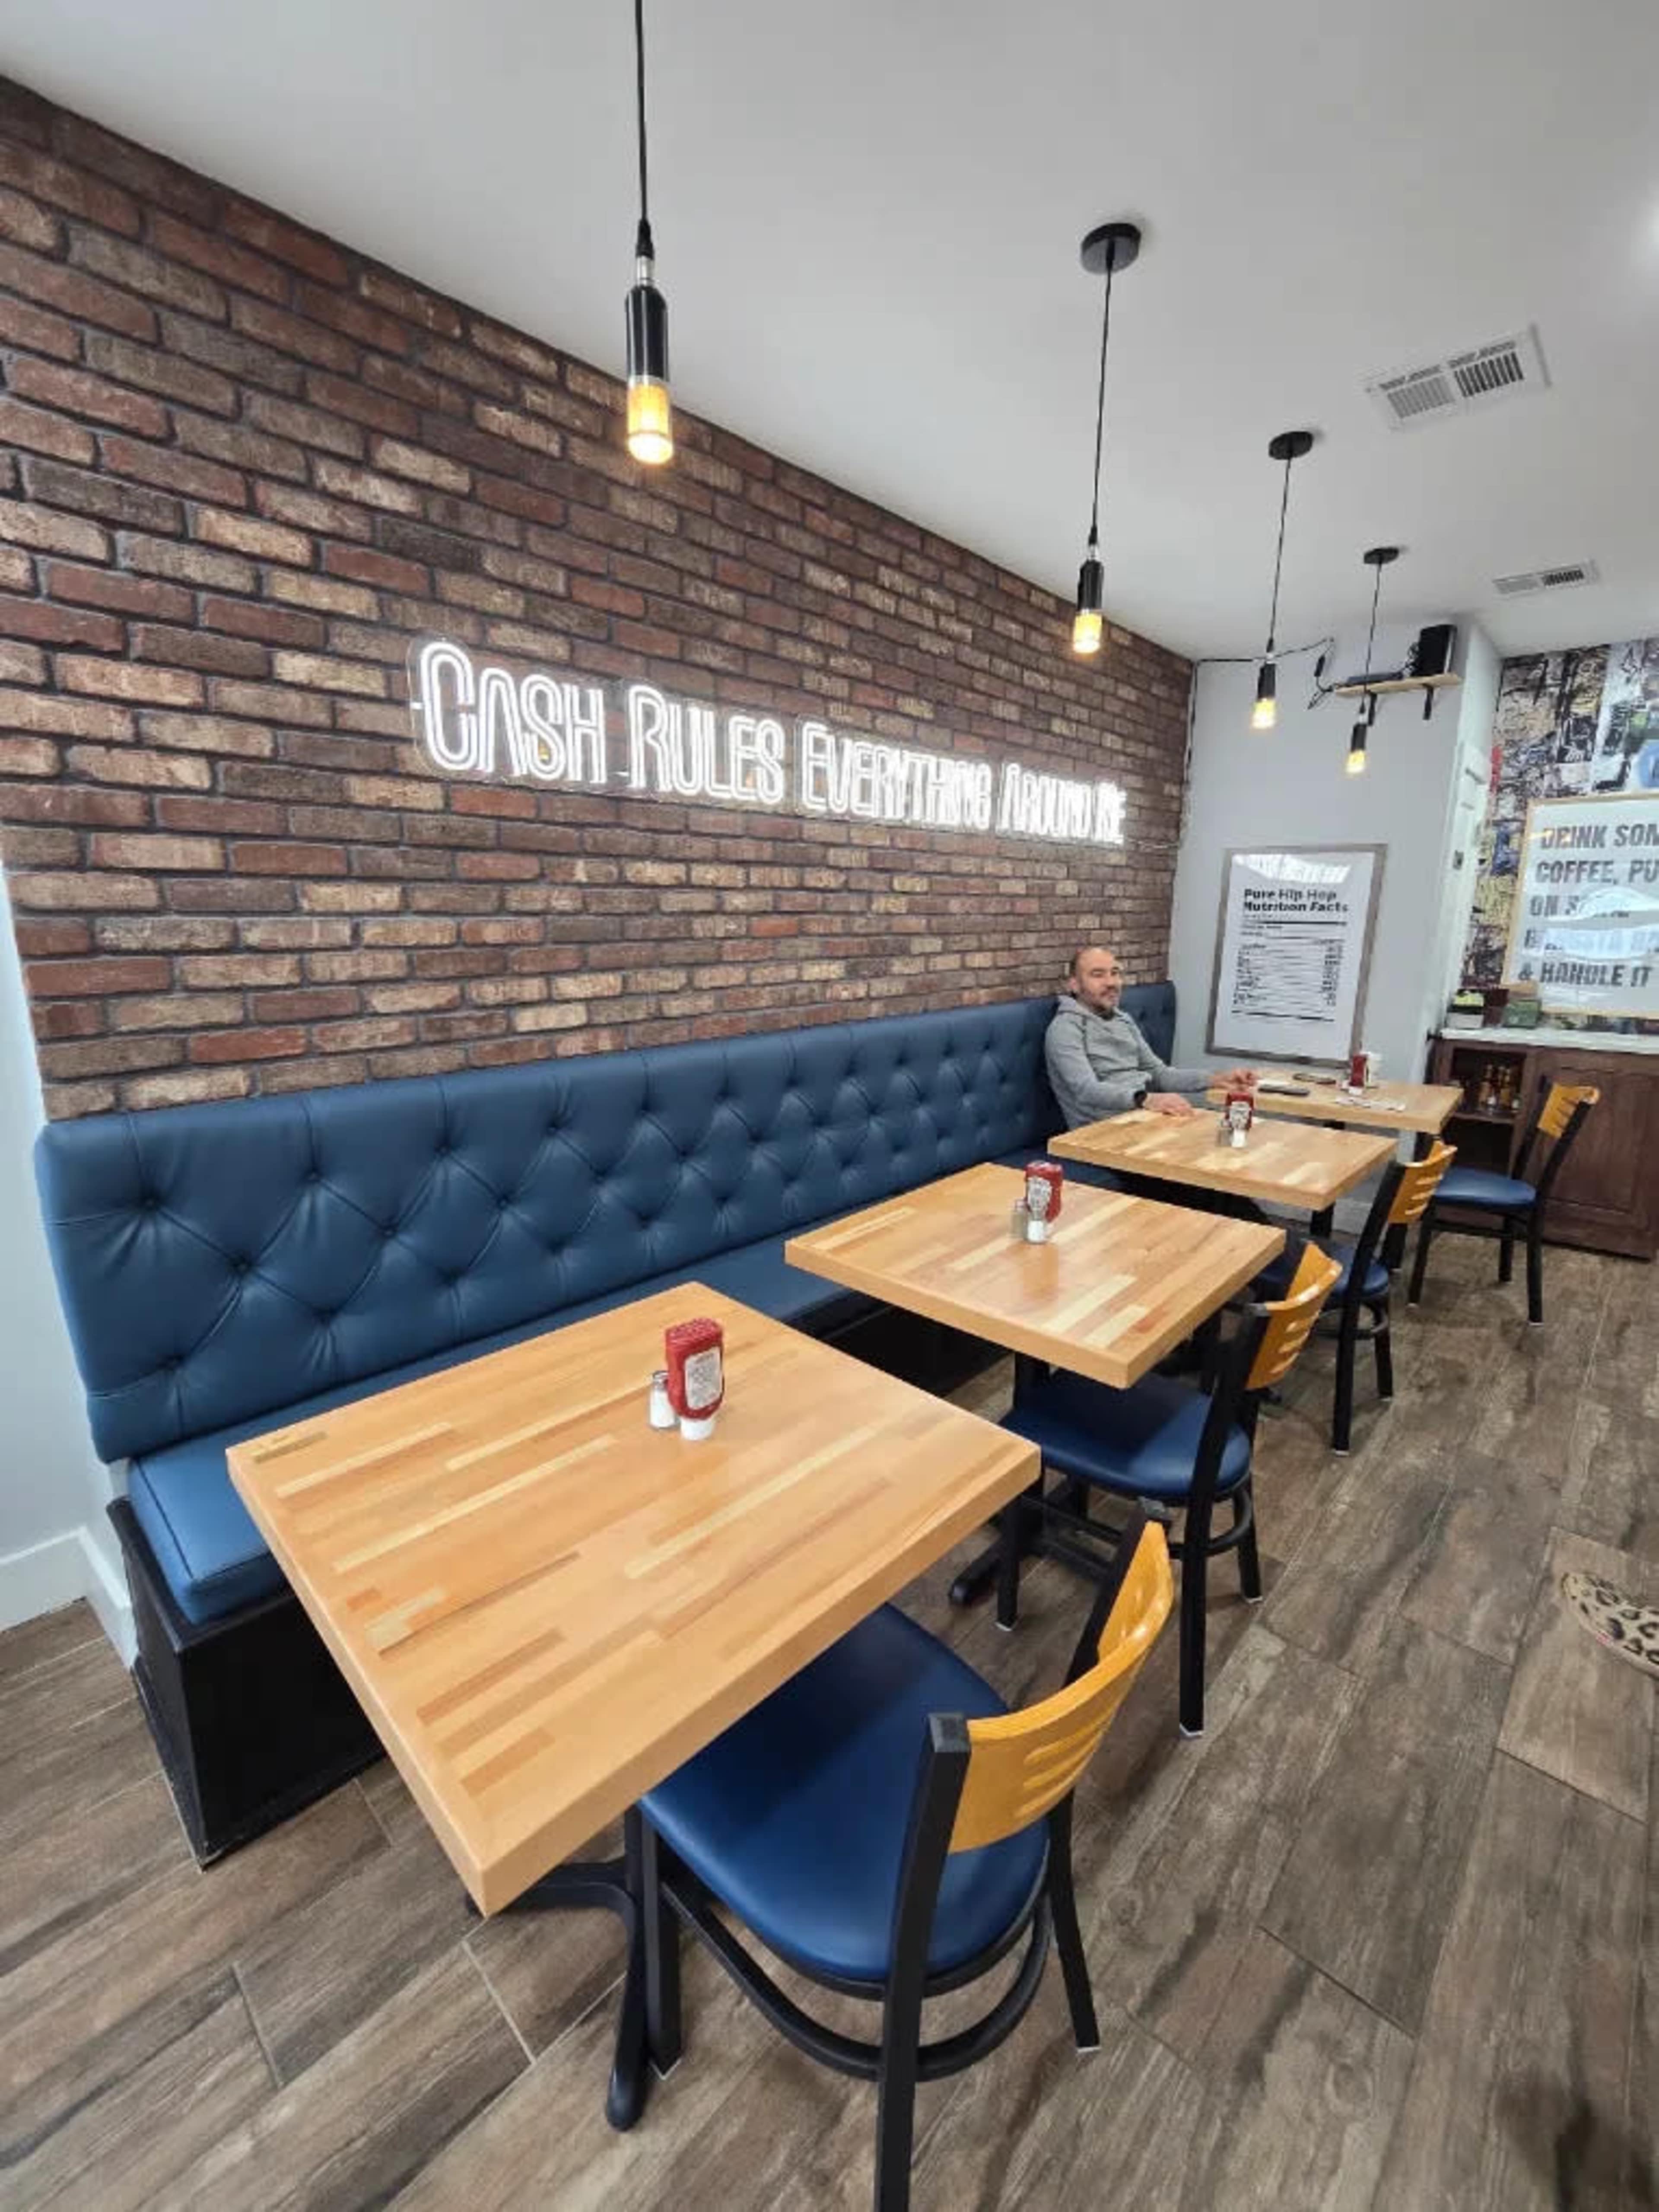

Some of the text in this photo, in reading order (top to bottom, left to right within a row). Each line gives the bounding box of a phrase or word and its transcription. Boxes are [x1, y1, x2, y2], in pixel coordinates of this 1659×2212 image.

[628, 684, 786, 804] RULES
[801, 721, 992, 830] EVERYTHING
[997, 763, 1092, 838] AROUND
[1541, 826, 1608, 849] DRINK
[1244, 889, 1337, 902] Pure Hip Hop
[1244, 901, 1348, 912] Nutrition Facts
[1540, 962, 1624, 986] HANDLE
